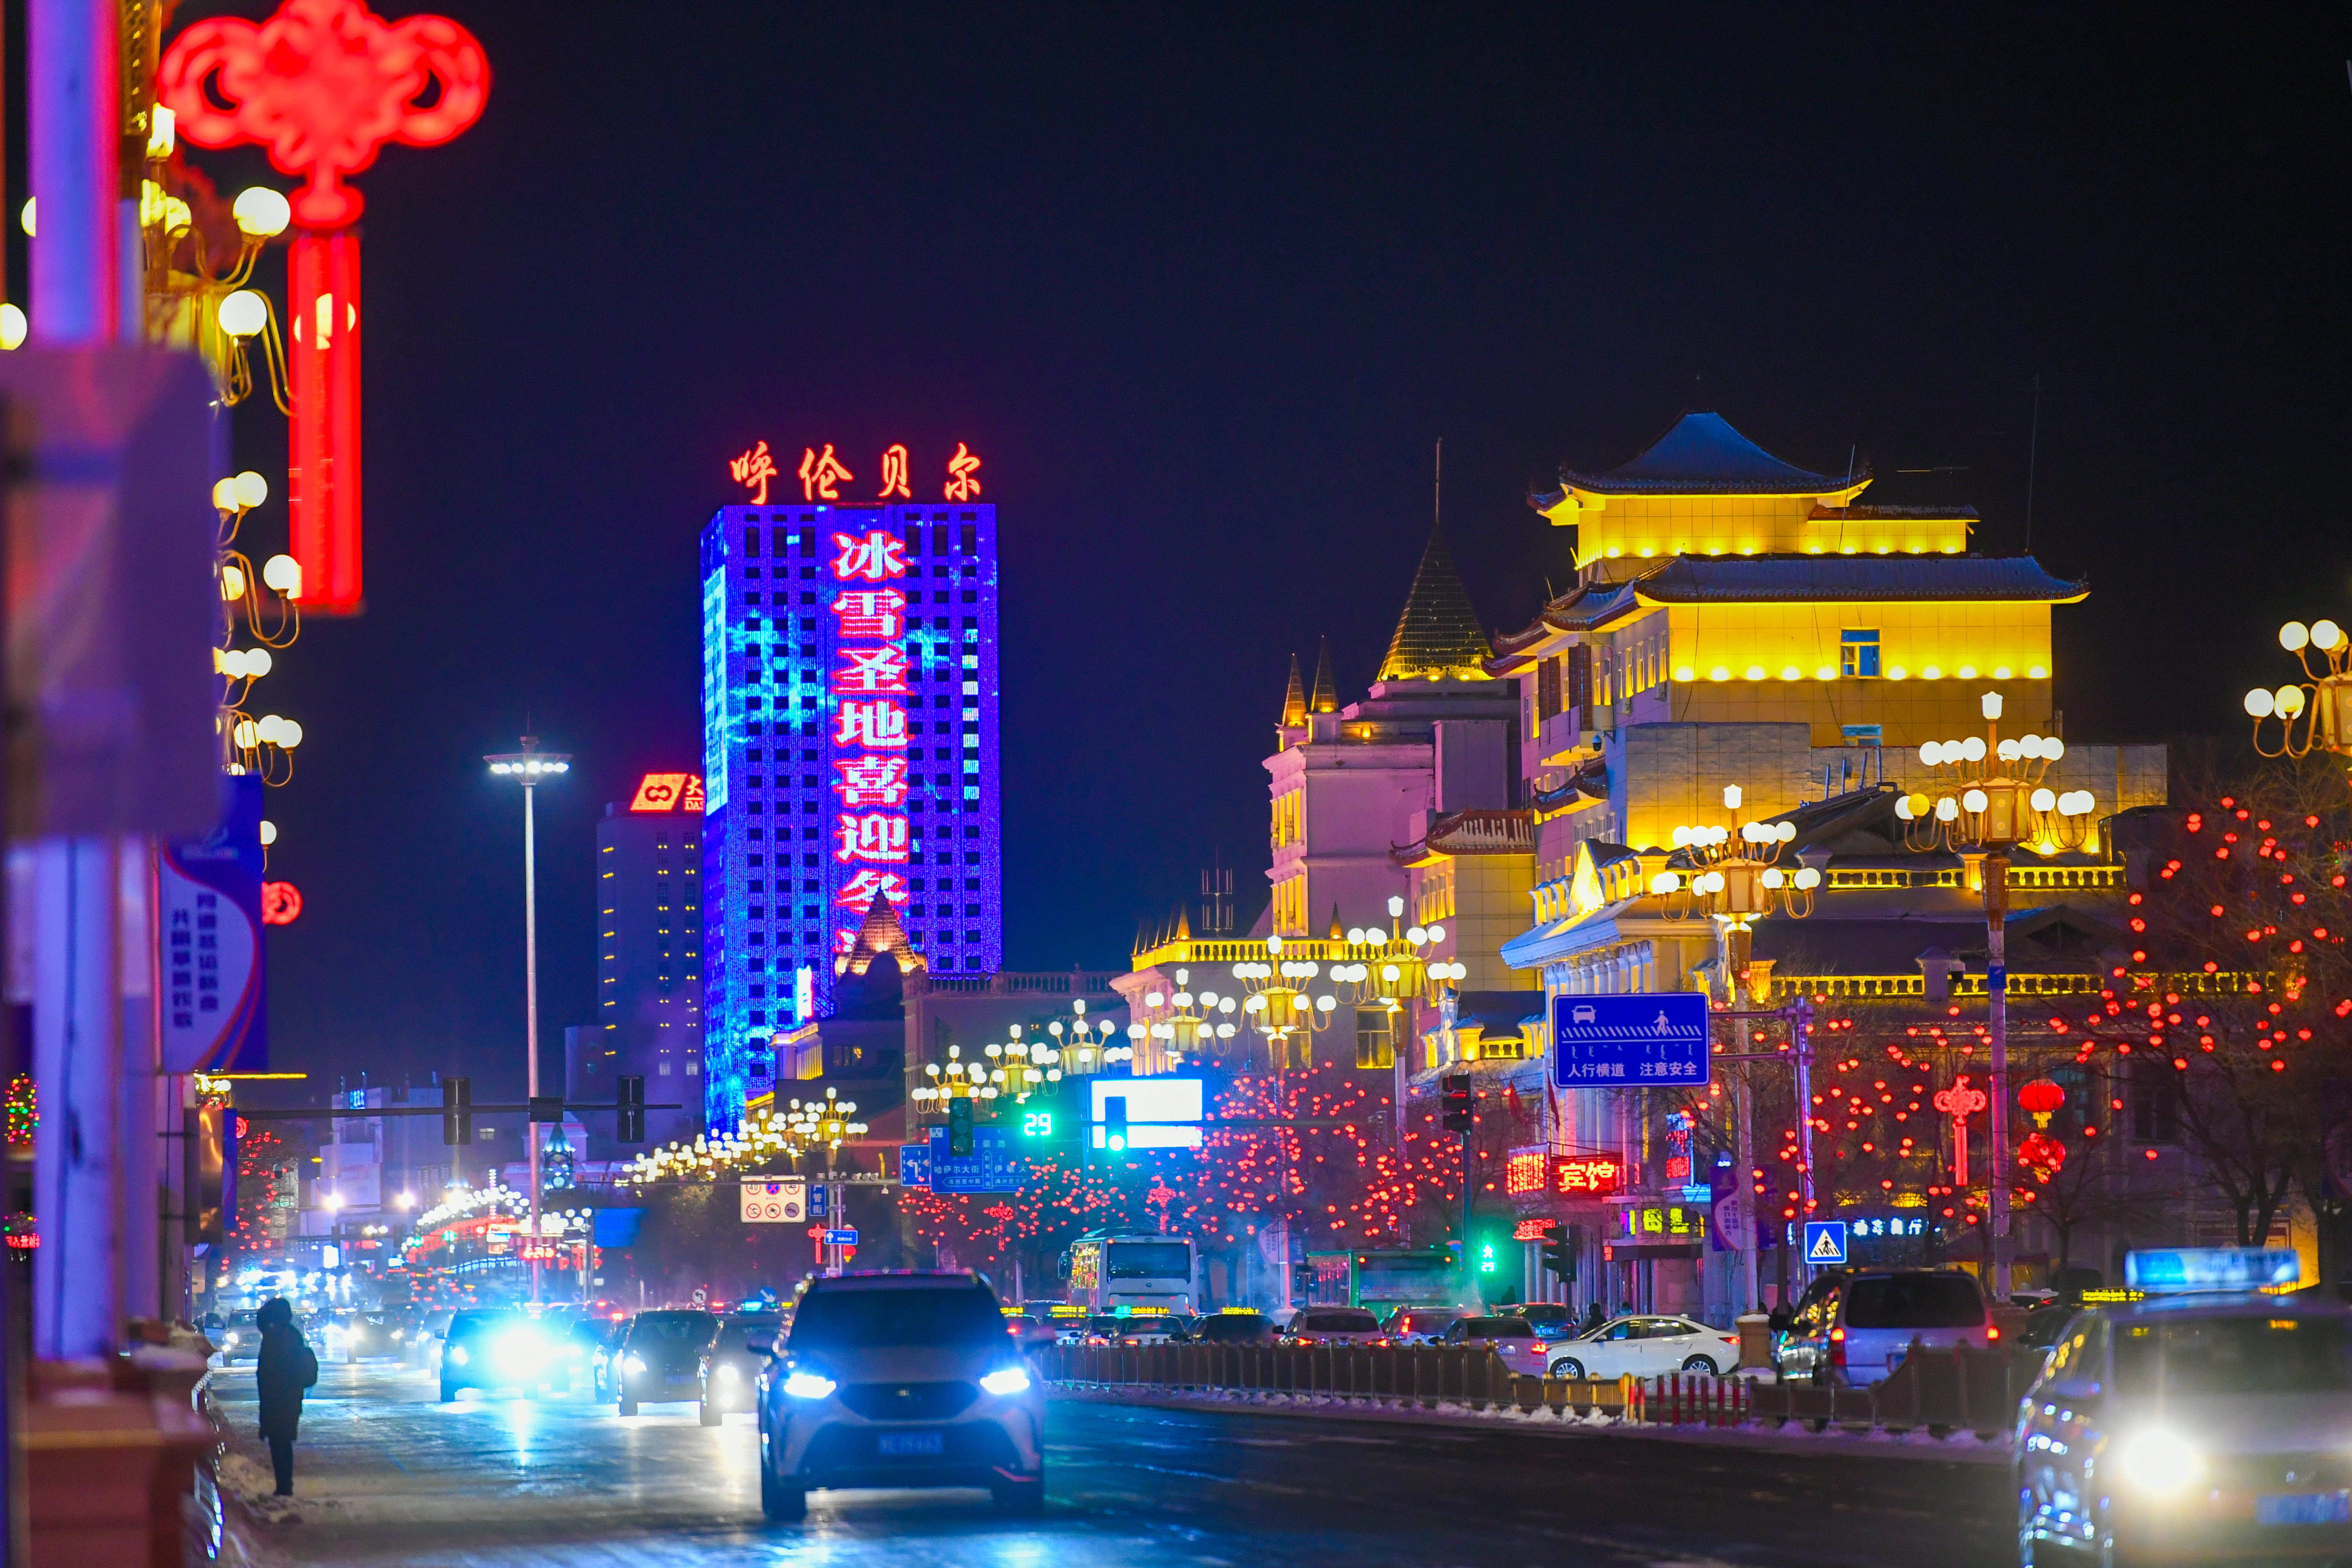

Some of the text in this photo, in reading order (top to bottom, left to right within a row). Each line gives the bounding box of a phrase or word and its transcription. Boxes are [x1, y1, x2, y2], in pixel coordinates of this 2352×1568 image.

[730, 441, 981, 505] 呼伦贝尔
[830, 530, 912, 953] 冰雪圣地喜迎冬
[1568, 1062, 1697, 1078] 人行横道 注意安全
[1024, 1113, 1052, 1136] 29
[934, 1165, 980, 1174] 哈萨尔大街
[1557, 1160, 1615, 1193] 宾馆
